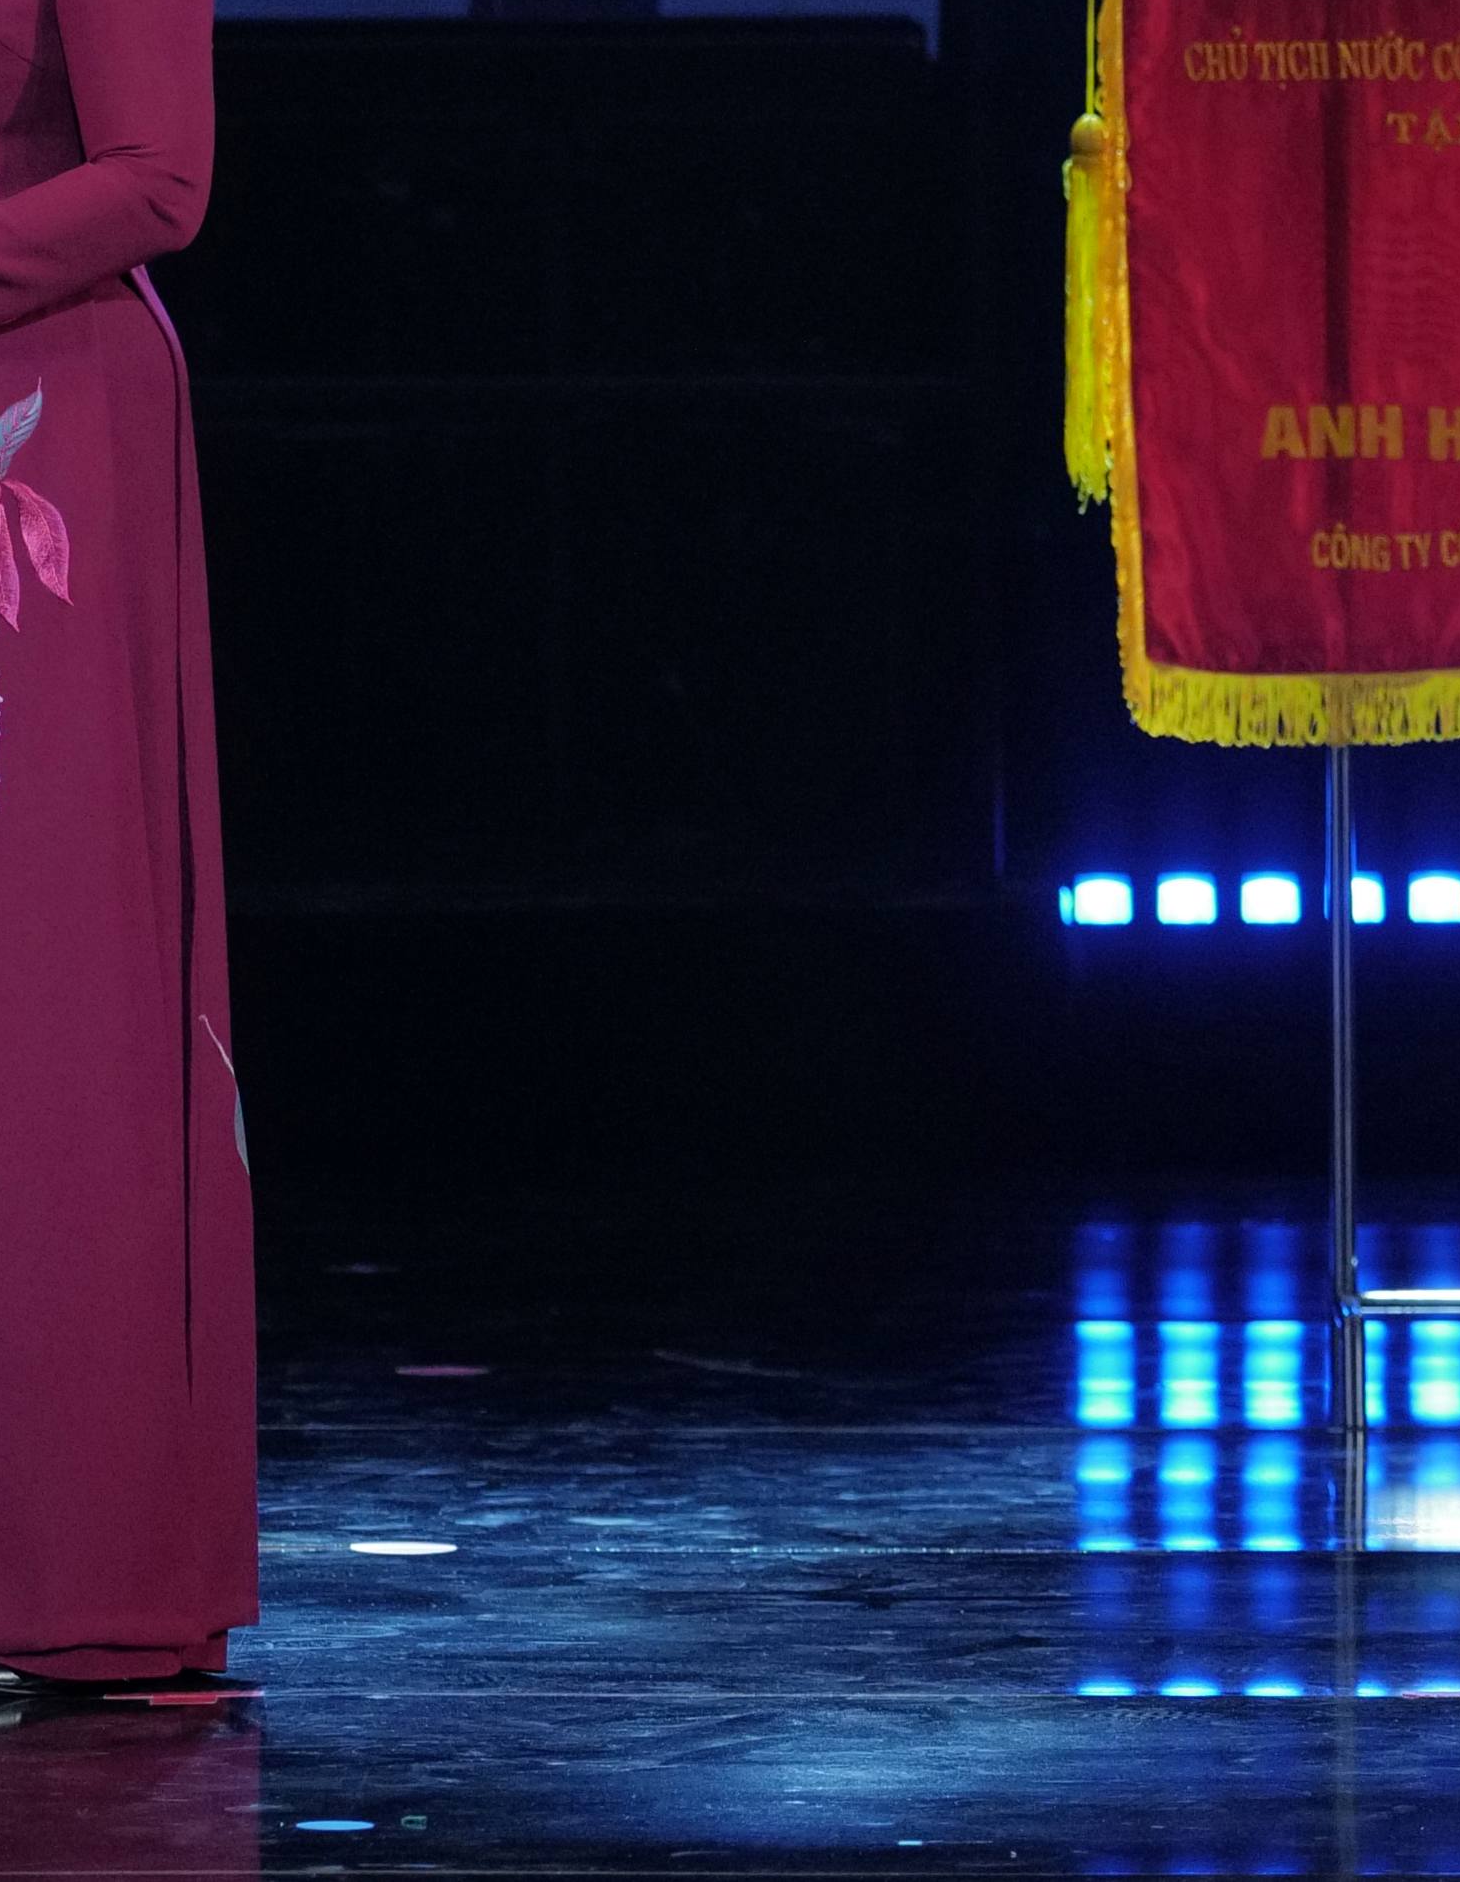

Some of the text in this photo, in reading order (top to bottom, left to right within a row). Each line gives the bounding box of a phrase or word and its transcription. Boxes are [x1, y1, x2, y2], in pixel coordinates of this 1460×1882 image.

[1184, 25, 1249, 83] CHỦ
[1254, 40, 1332, 92] TỊCH
[1337, 29, 1426, 81] NƯỚC
[1260, 403, 1405, 460] ANH
[1310, 521, 1392, 573] CÔNG
[1395, 531, 1432, 570] TY
